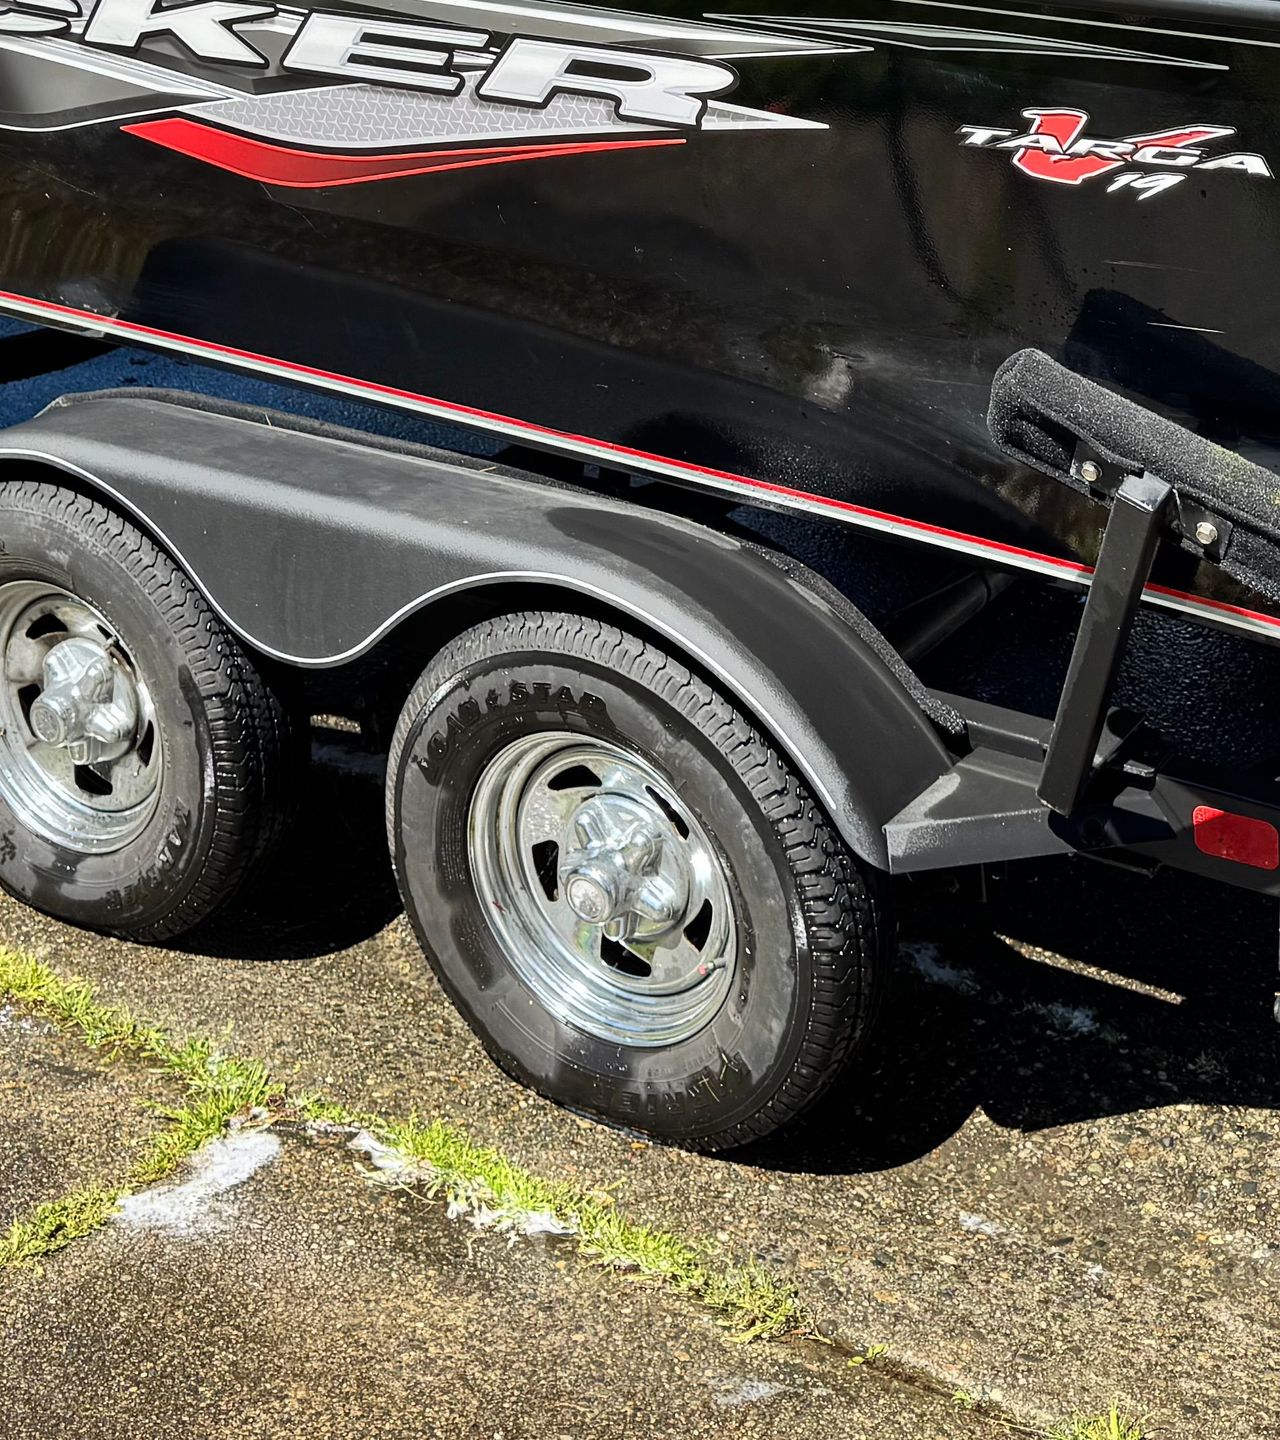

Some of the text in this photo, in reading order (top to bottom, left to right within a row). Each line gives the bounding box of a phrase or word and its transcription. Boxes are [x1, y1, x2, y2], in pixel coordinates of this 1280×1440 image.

[957, 122, 1274, 178] TARGA
[1106, 172, 1188, 200] 19
[509, 679, 610, 716] STAR
